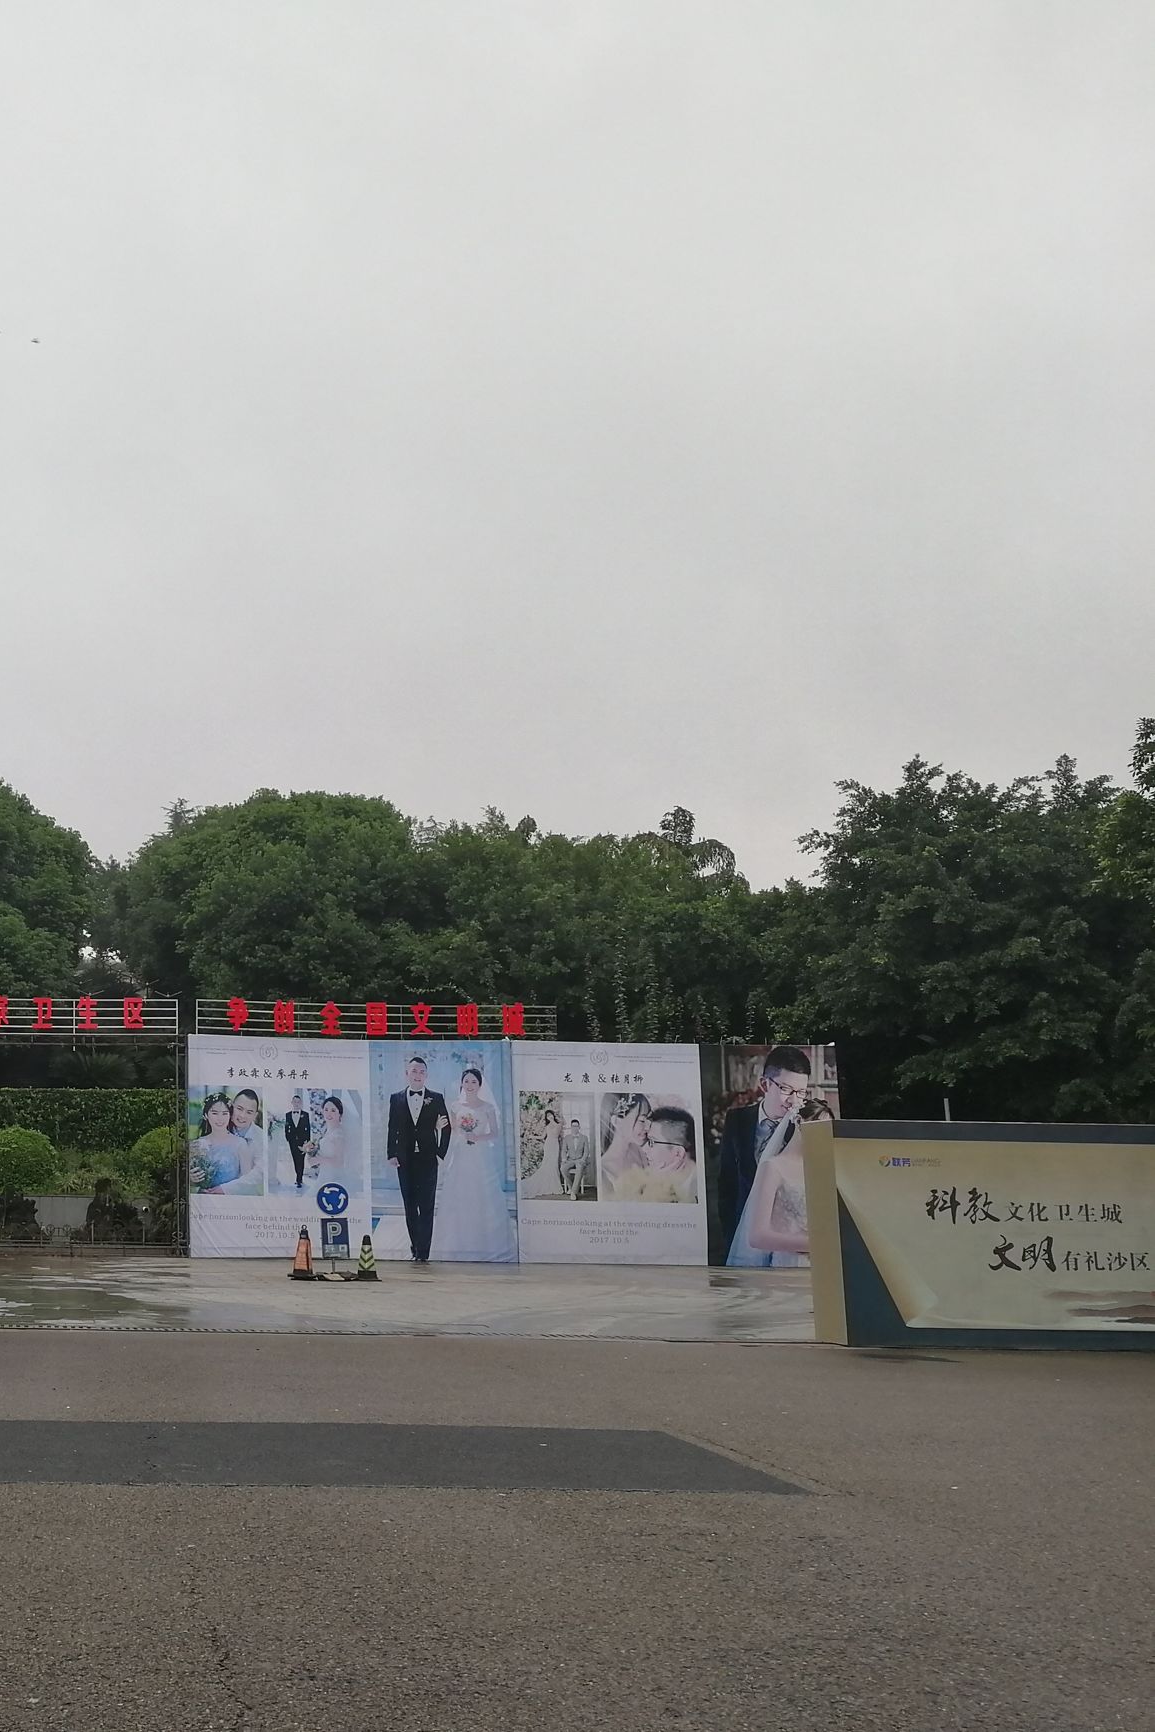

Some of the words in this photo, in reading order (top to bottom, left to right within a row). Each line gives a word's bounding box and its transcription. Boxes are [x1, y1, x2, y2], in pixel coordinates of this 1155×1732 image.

[226, 996, 526, 1037] 争创全国文明城
[925, 1186, 1123, 1225] 科教文化卫生城
[326, 1221, 343, 1244] P
[988, 1234, 1151, 1273] 文明有礼沙区
